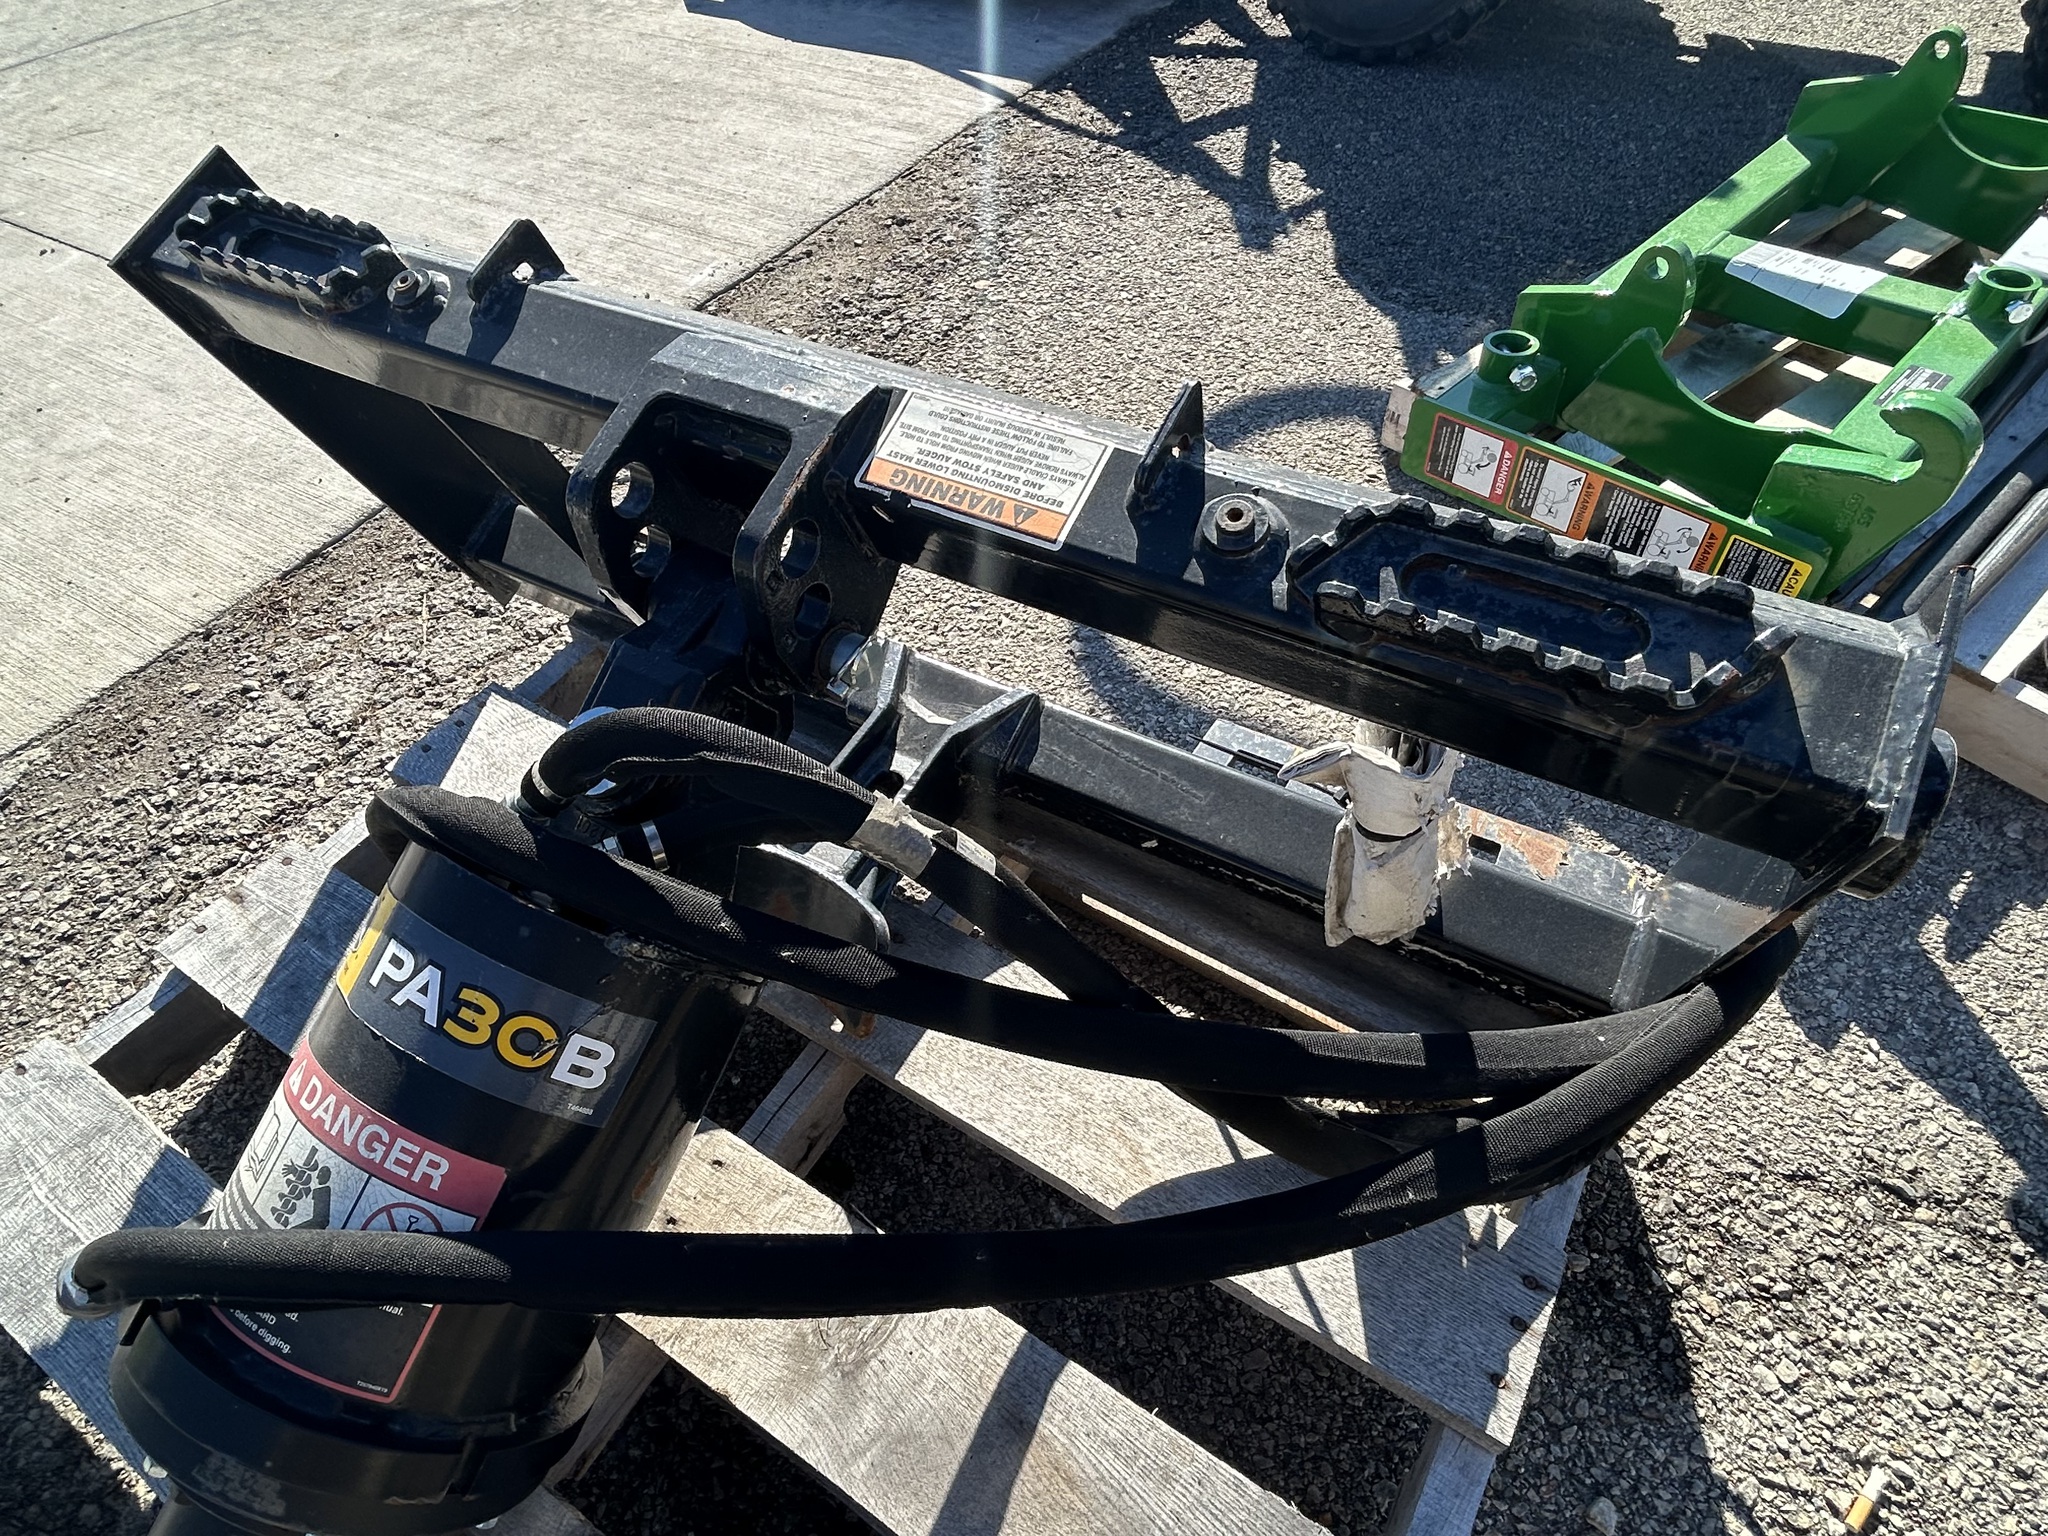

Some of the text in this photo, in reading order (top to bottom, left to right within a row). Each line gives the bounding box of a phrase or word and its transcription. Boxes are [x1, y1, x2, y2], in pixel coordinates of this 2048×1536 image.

[972, 413, 985, 422] OR
[910, 425, 930, 436] FROM
[926, 409, 1074, 456] FAILURE TO FOLLOW THESE INSTRUCTIONS COULD
[938, 424, 969, 438] POSITION.
[1032, 429, 1042, 438] IN
[914, 434, 925, 443] TO
[940, 433, 951, 442] TO
[985, 437, 995, 445] IN
[1040, 432, 1066, 444] RESULT
[939, 442, 959, 453] FROM
[948, 436, 995, 455] TRANSPORTING
[993, 439, 1016, 452] AUGER
[1014, 446, 1029, 455] PUT
[957, 447, 984, 460] MOVING
[982, 454, 1003, 466] WHEN
[992, 448, 1014, 460] WHEN
[1011, 454, 1034, 466] AUGER
[1027, 449, 1050, 461] NEVER
[913, 446, 1046, 491] AND SAFELY STOW AUGER.
[1000, 460, 1024, 472] AUGER
[1032, 460, 1060, 474] REMOVE
[885, 448, 1064, 508] BEFORE DISMOUNTING LOWER MAST
[1047, 473, 1076, 487] ALWAYS
[1058, 467, 1087, 481] ALWAYS
[1493, 457, 1511, 495] DANGER
[885, 466, 1009, 519] WARNING
[1571, 488, 1593, 531] WARNING
[1693, 539, 1715, 573] WARNI
[367, 937, 617, 1090] PA30B
[298, 1077, 451, 1192] DANGER
[257, 1326, 292, 1355] digging.
